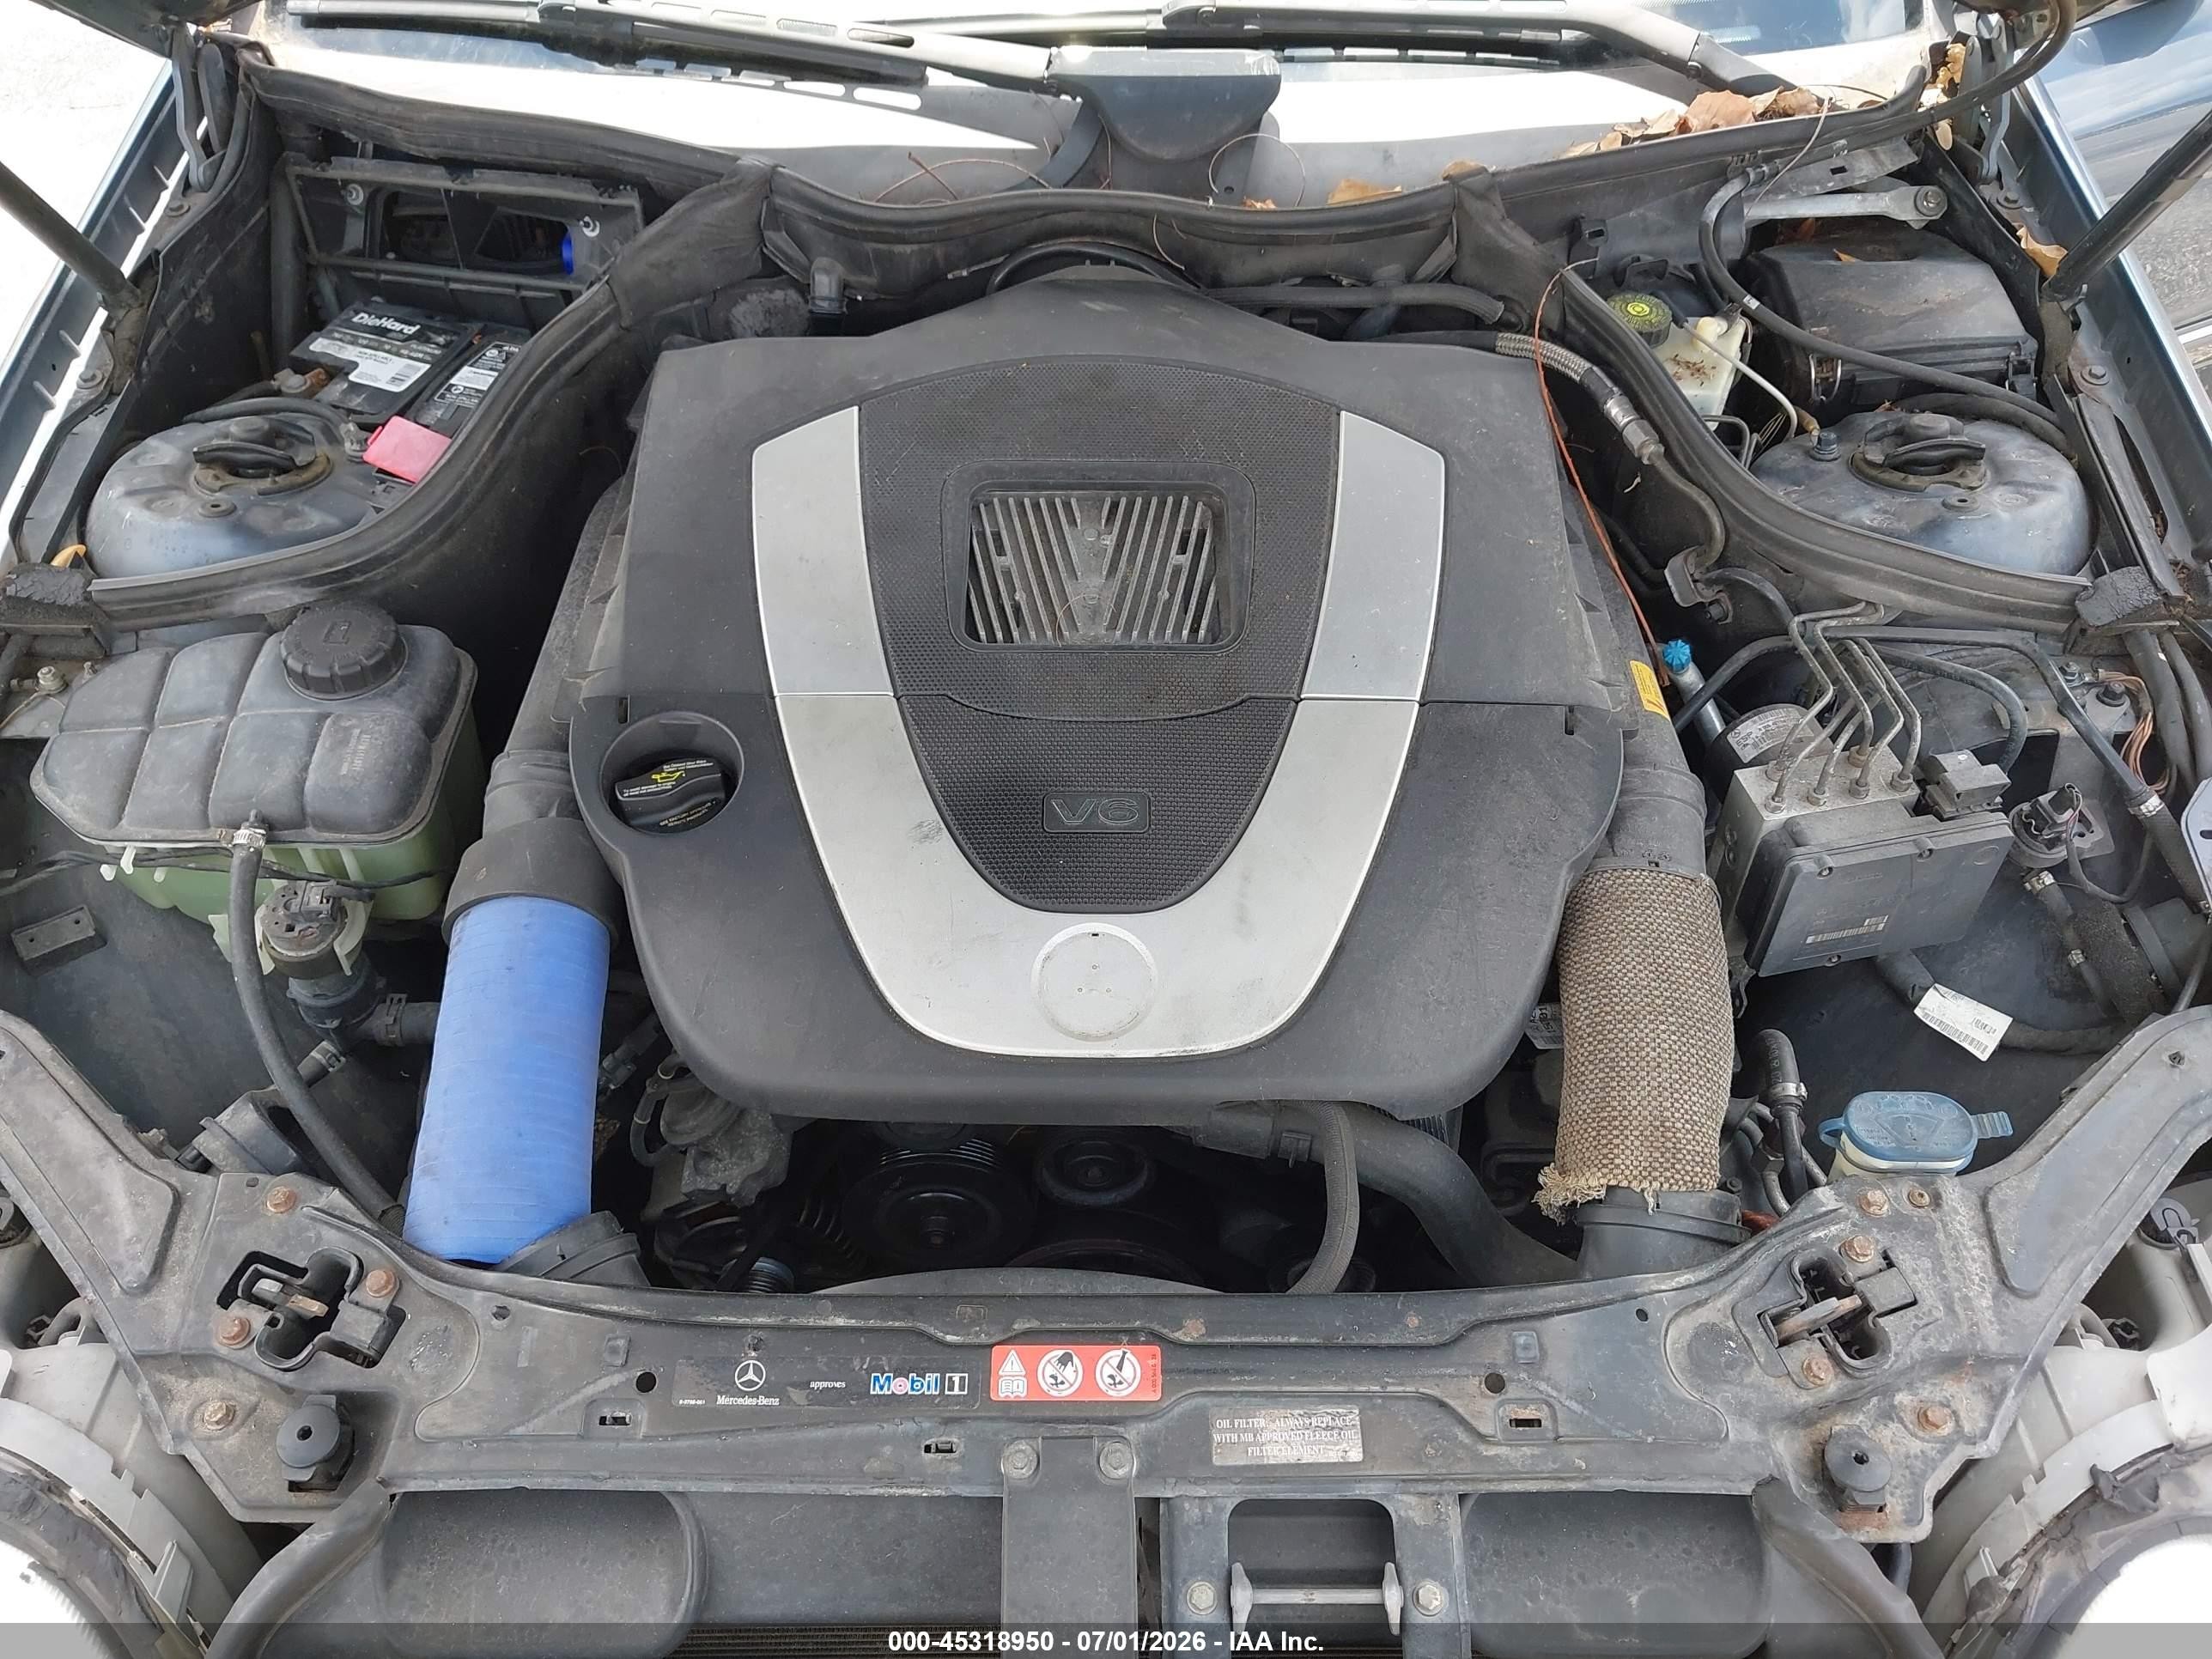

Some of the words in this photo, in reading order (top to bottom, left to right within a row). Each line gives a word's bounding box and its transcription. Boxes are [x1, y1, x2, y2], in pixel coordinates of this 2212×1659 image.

[351, 312, 421, 335] DieHard
[1735, 731, 1753, 747] ESP
[1050, 798, 1139, 824] V6
[716, 1395, 781, 1406] Mercedes-Benz
[810, 1381, 847, 1390] approves
[870, 1373, 939, 1395] Mobil
[1216, 1419, 1232, 1429] OIL
[1275, 1417, 1310, 1428] ALWAYS
[1311, 1416, 1352, 1426] REPLACE
[1213, 1433, 1237, 1443] WITH
[1239, 1432, 1254, 1443] MB
[1255, 1431, 1304, 1442] APPROVED
[1305, 1430, 1340, 1441] FLEECE
[1341, 1430, 1357, 1440] OIL
[1248, 1446, 1280, 1456] FILTER
[1281, 1444, 1323, 1455] ELEMENT
